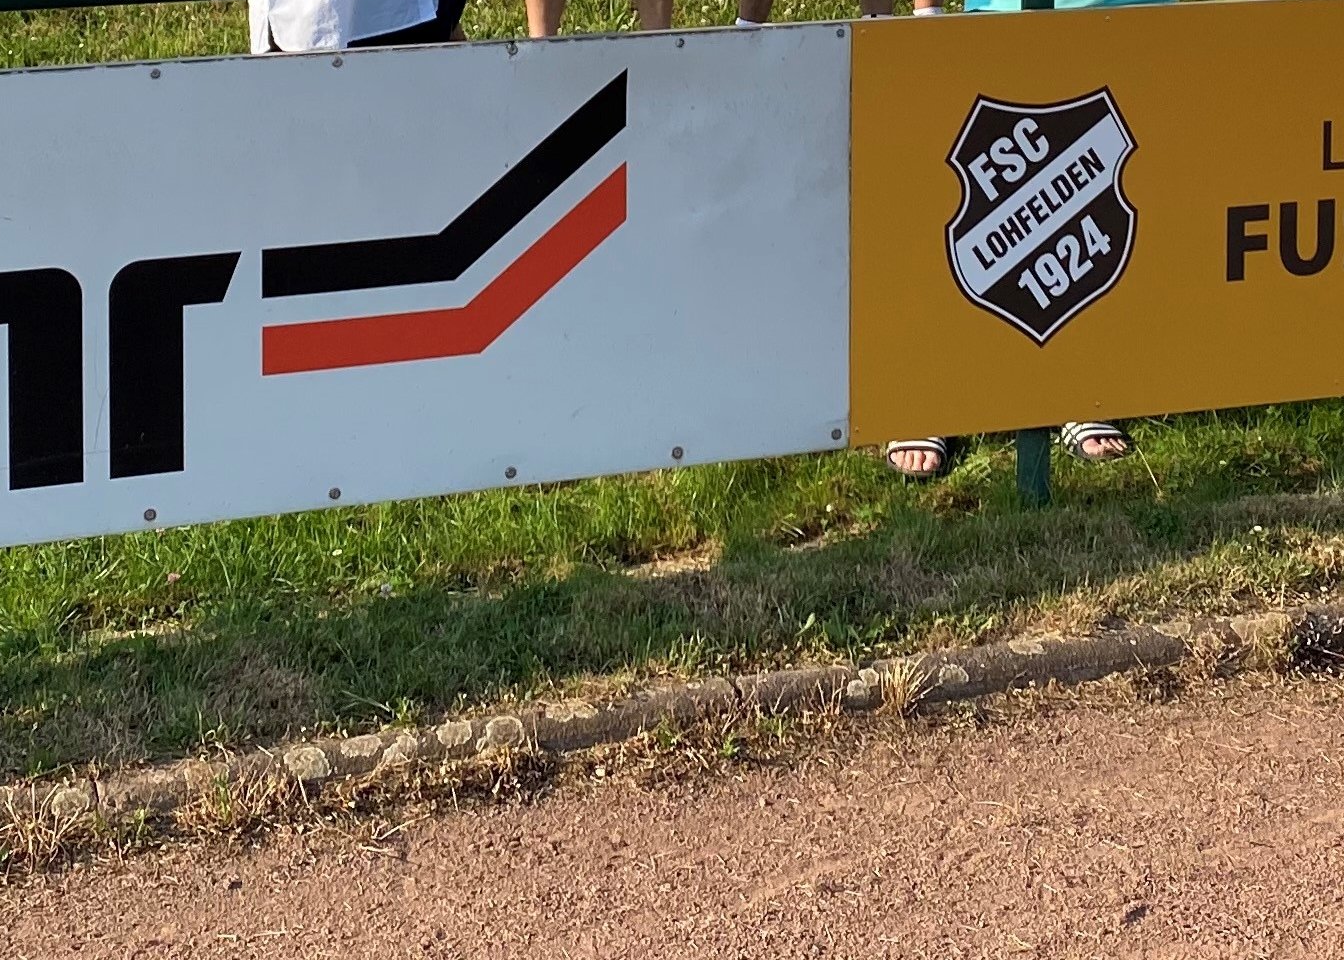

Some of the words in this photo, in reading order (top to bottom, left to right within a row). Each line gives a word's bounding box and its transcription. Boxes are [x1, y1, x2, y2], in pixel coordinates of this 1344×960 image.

[967, 117, 1049, 202] FSC
[971, 147, 1106, 271] LOHFELDEN
[1018, 214, 1111, 310] 1924
